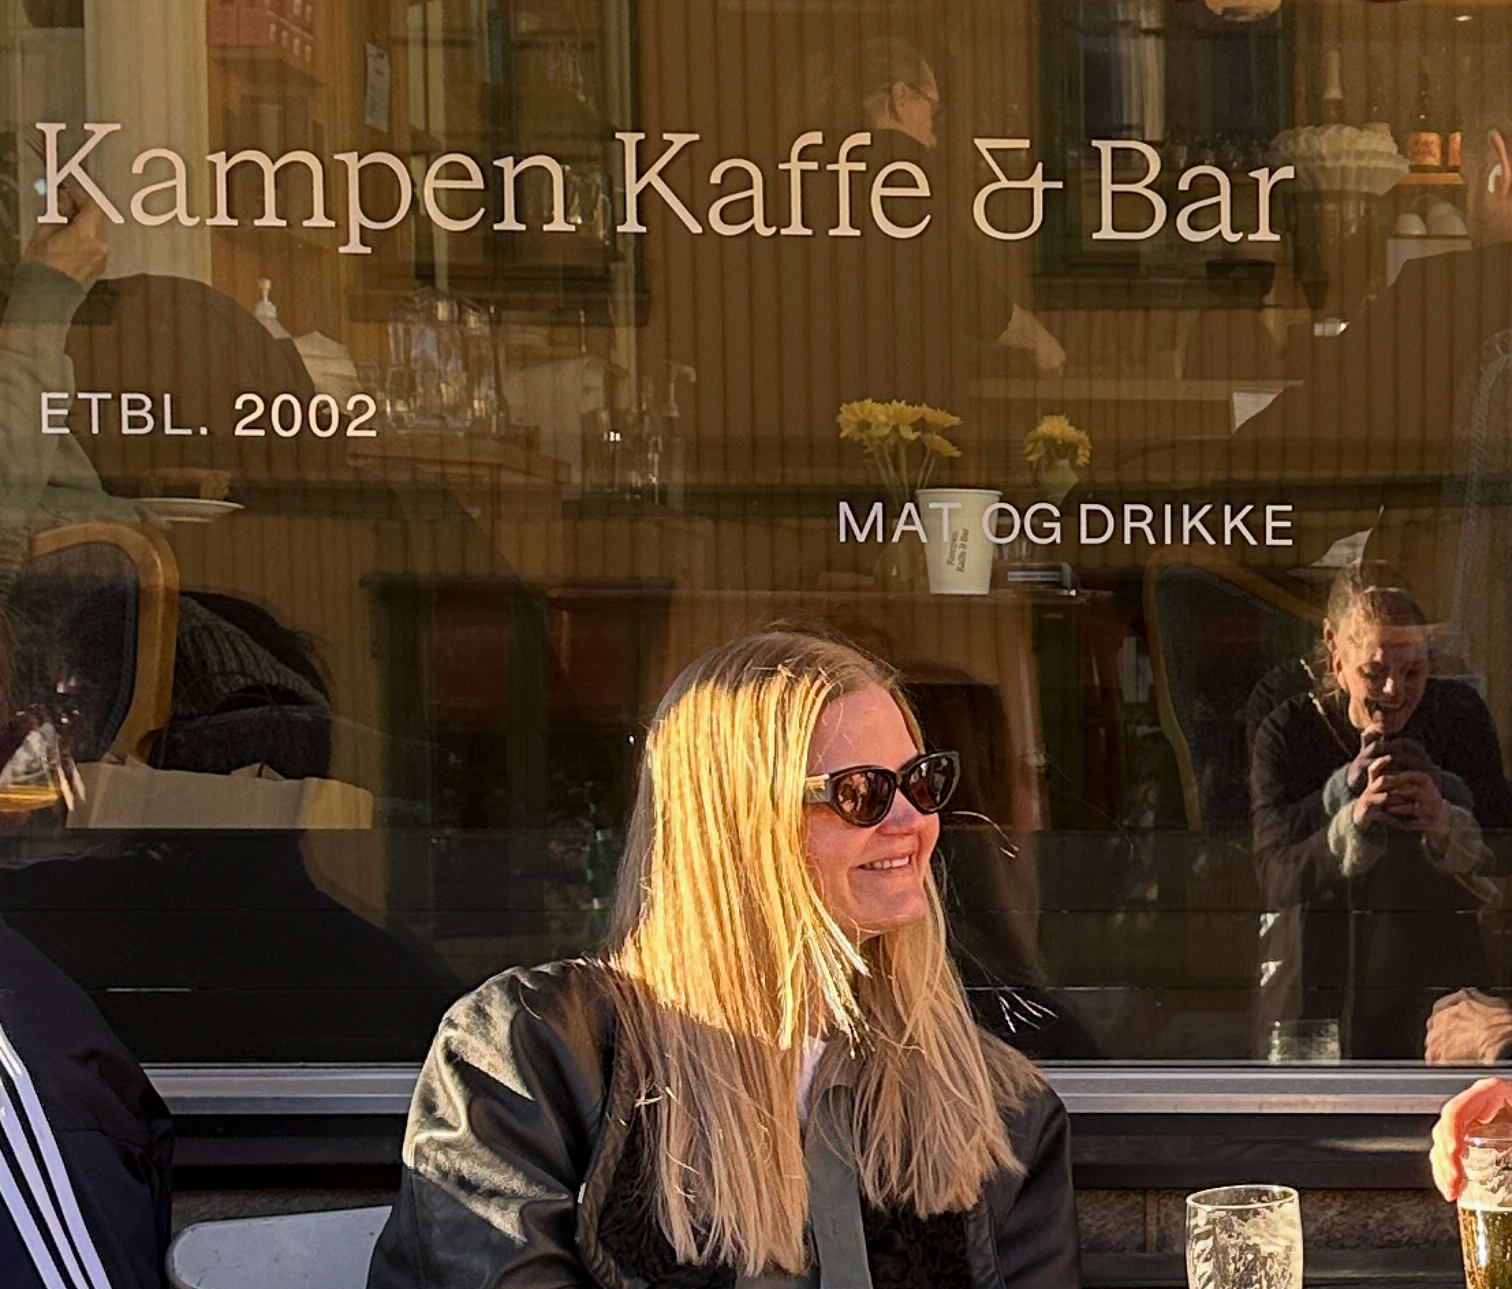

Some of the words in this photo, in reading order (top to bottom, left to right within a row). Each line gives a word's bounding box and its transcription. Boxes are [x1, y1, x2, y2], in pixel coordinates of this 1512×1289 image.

[35, 121, 577, 254] Kampen
[614, 130, 932, 240] Kaffe
[972, 138, 1064, 241] &
[1091, 138, 1296, 243] Bar
[40, 391, 209, 437] ETBL.
[233, 392, 379, 438] 2002
[838, 501, 963, 544] MAT
[981, 502, 1062, 545] OG
[1079, 502, 1296, 547] DRIKKE
